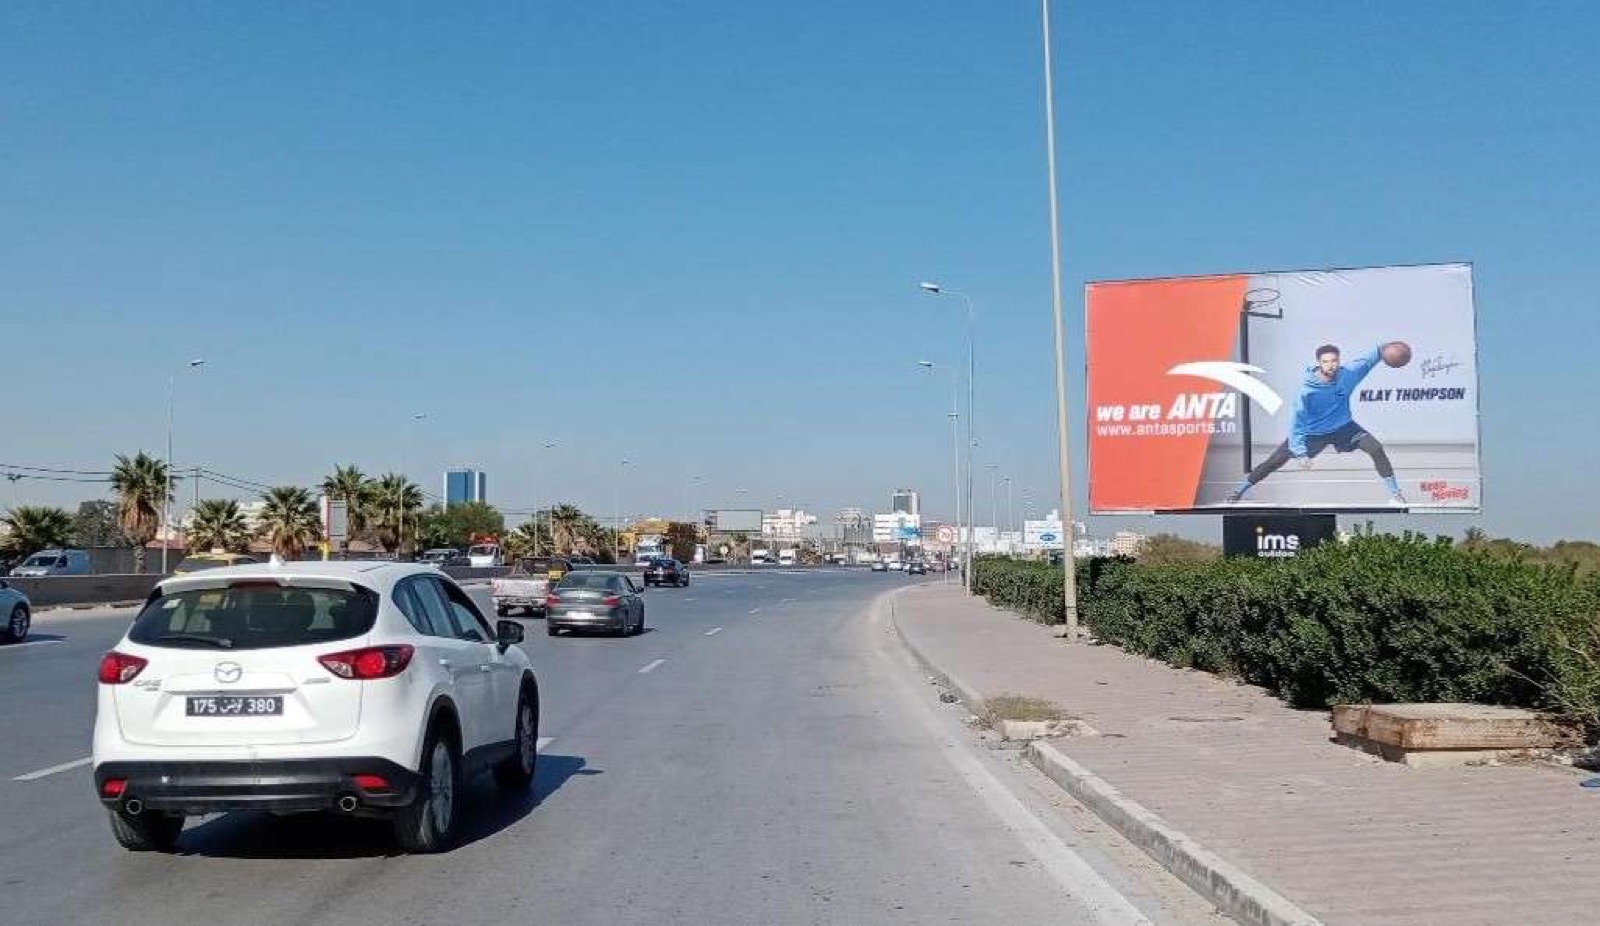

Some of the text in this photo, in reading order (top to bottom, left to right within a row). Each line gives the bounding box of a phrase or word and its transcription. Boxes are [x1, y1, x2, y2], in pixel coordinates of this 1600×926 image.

[1360, 387, 1465, 401] KLAY THOMPSON
[1097, 392, 1236, 421] we are ANTA
[1097, 420, 1236, 437] www.antasports.tn
[1256, 526, 1300, 550] ims
[193, 699, 217, 713] 175
[247, 699, 275, 712] 380
